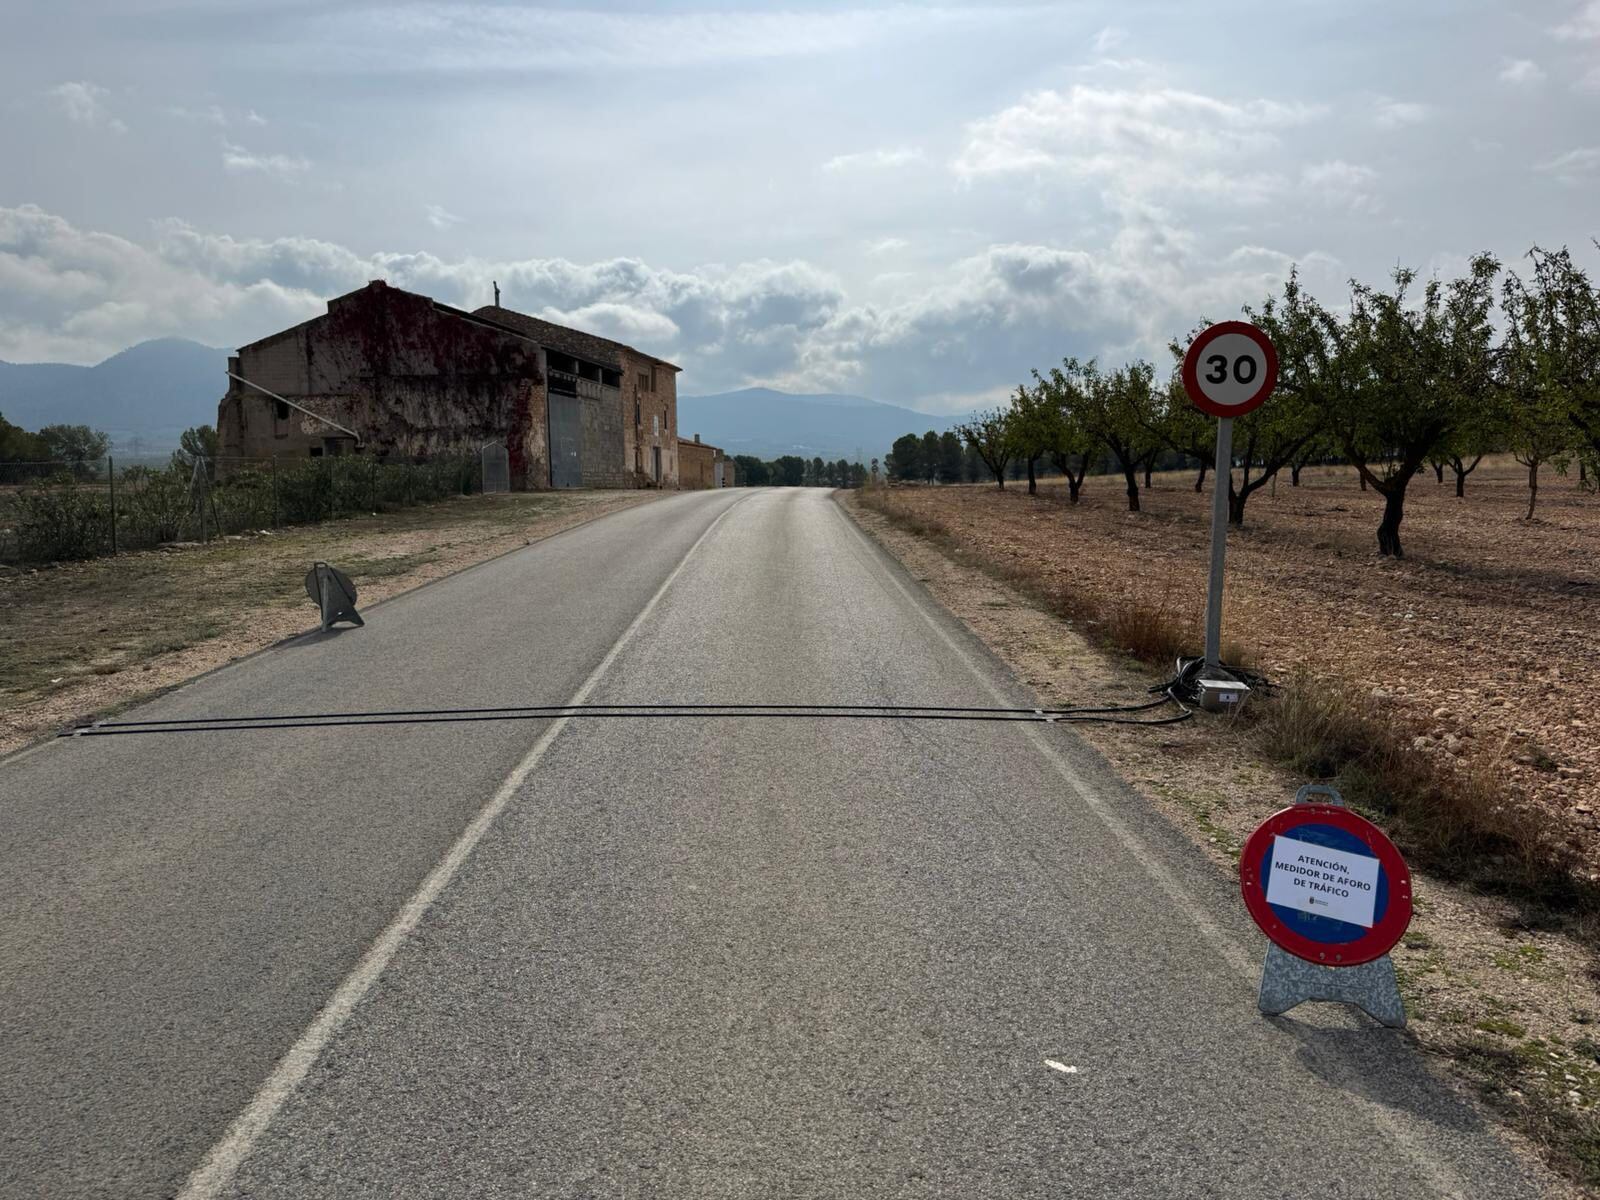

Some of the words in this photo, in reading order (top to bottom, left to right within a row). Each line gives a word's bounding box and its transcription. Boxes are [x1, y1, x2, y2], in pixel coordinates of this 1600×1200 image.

[1205, 354, 1257, 385] 30
[1275, 861, 1320, 878] MEDIDOR
[1323, 872, 1335, 882] DE
[1337, 876, 1371, 891] AFORO
[1298, 855, 1350, 875] ATENCIÓN,
[1294, 878, 1306, 887] DE
[1309, 880, 1349, 898] TRÁFICO
